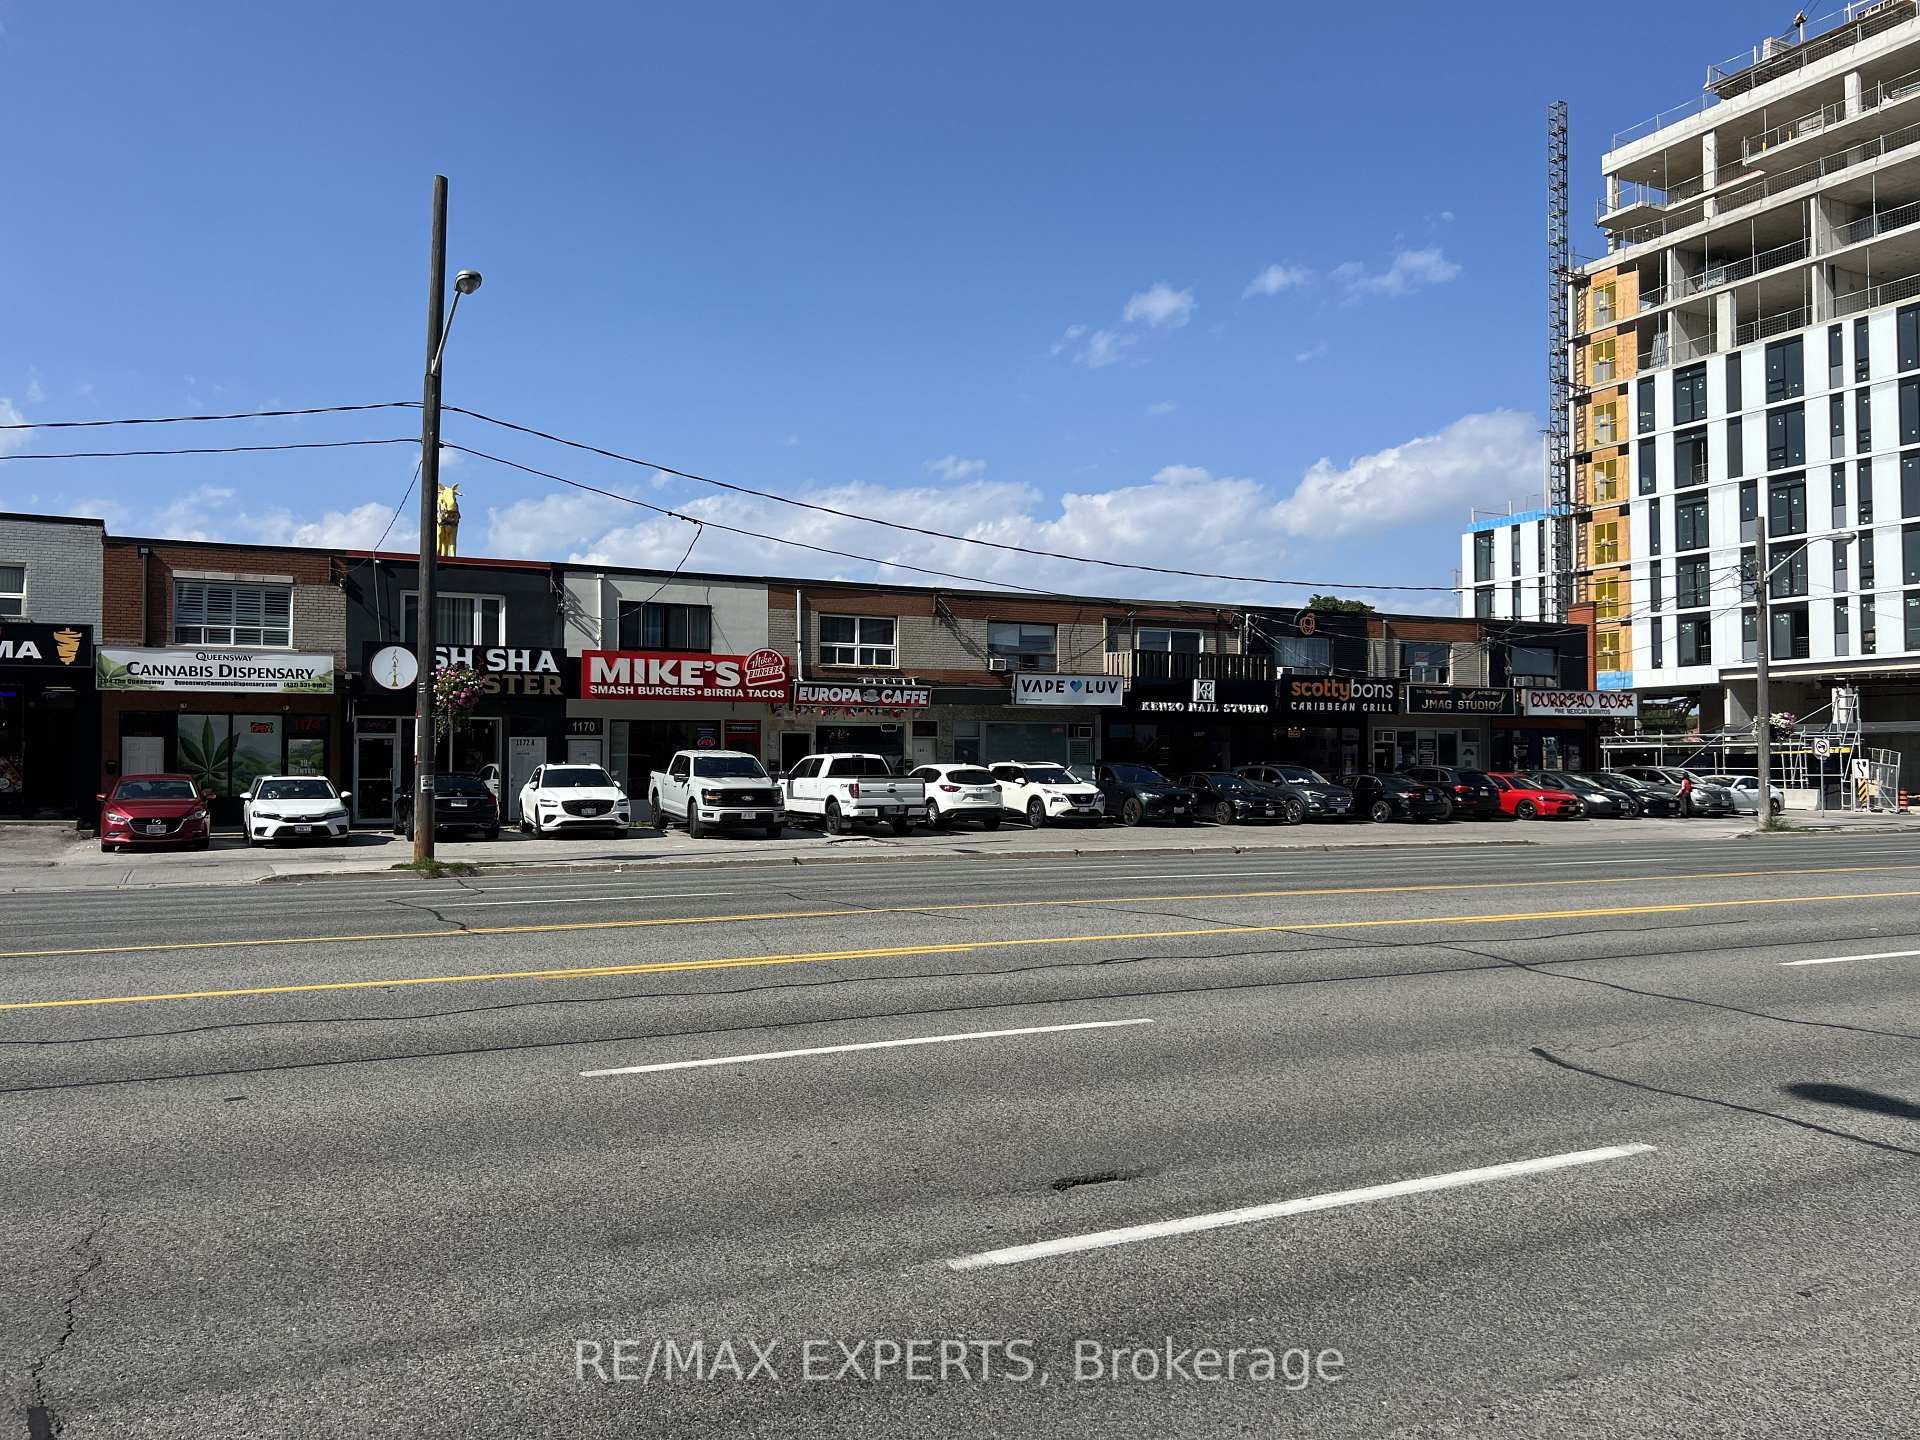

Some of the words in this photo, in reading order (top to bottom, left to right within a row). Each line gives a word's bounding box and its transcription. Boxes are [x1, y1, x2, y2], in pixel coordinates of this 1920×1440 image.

[195, 652, 253, 662] QUEENSWAY
[750, 652, 778, 668] Mike's
[126, 661, 213, 678] CANNABIS
[218, 664, 315, 680] DISPENSARY
[590, 657, 741, 687] MIKE'S
[750, 666, 781, 677] BURGERS
[483, 674, 564, 696] STER
[590, 685, 634, 695] SMASH
[638, 686, 696, 696] BURGERS
[704, 688, 744, 698] BIRRIA
[747, 689, 785, 698] TACOS
[1021, 679, 1065, 693] VAPE
[1086, 681, 1119, 694] LUV
[1291, 679, 1394, 701] scottybons
[798, 687, 862, 702] EUROPA
[881, 689, 928, 704] CAFFE
[1141, 701, 1185, 711] KENZO
[1188, 702, 1219, 712] NAIL
[1224, 703, 1269, 713] STUDIO
[1291, 701, 1355, 711] CARIBBEAN
[1362, 703, 1393, 712] GRILL
[1422, 699, 1452, 709] JMAG
[572, 721, 595, 732] 1170
